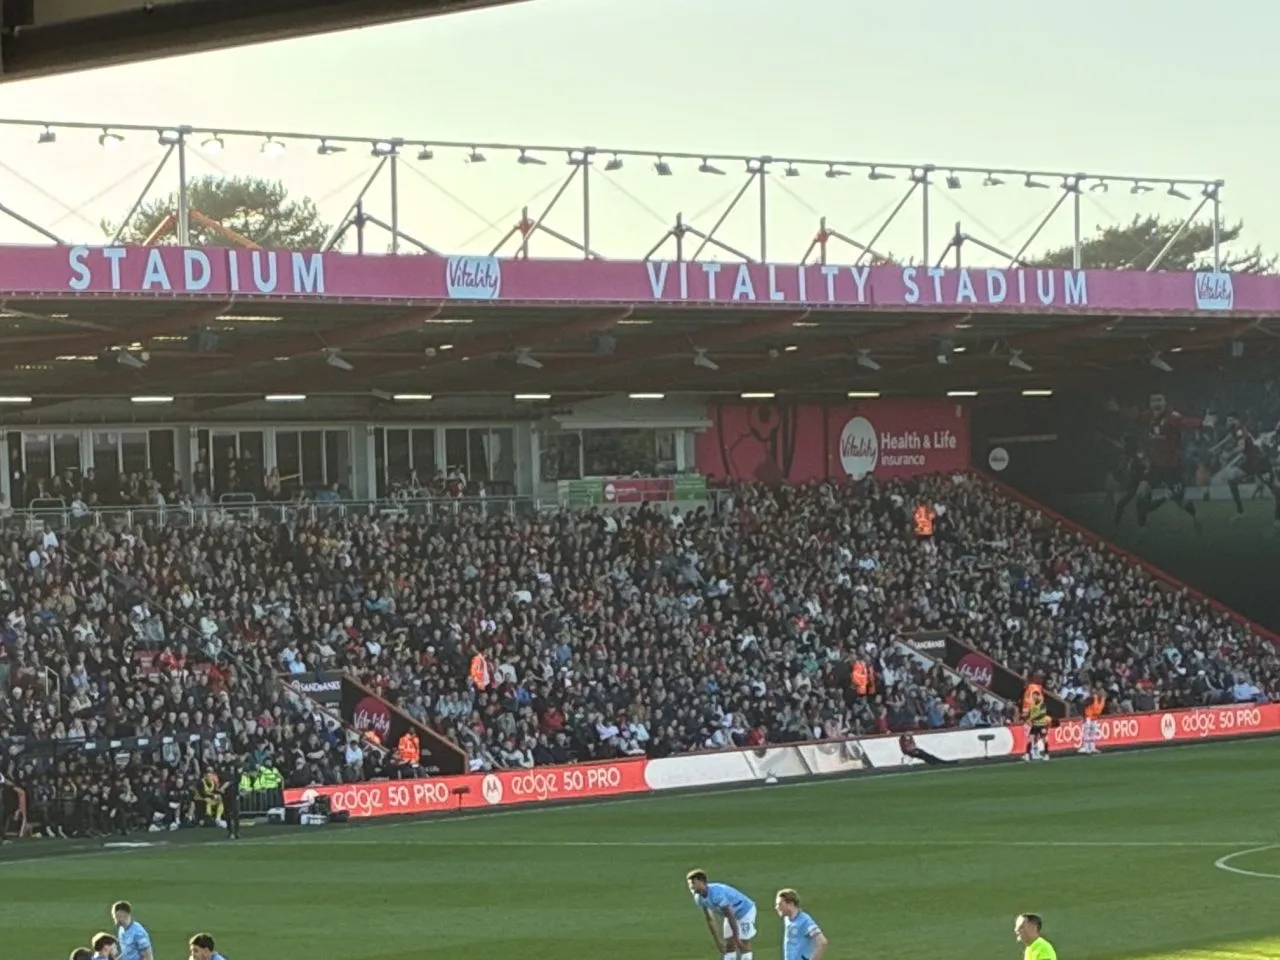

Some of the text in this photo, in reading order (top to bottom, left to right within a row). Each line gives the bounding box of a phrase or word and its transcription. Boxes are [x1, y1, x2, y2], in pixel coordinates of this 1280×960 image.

[69, 247, 325, 294] STADIUM
[449, 256, 498, 298] Vitality
[645, 261, 1088, 305] VITALITY STADIUM
[840, 433, 876, 460] Vitality
[881, 430, 957, 449] Health & Life
[881, 452, 925, 466] insurance
[1054, 721, 1083, 748] edg
[1113, 719, 1139, 738] PRO
[1182, 708, 1261, 737] edge 50 PRO
[332, 782, 449, 816] edge 50 PRO
[511, 772, 558, 800] edge
[563, 770, 584, 792] 50
[587, 767, 620, 789] PRO
